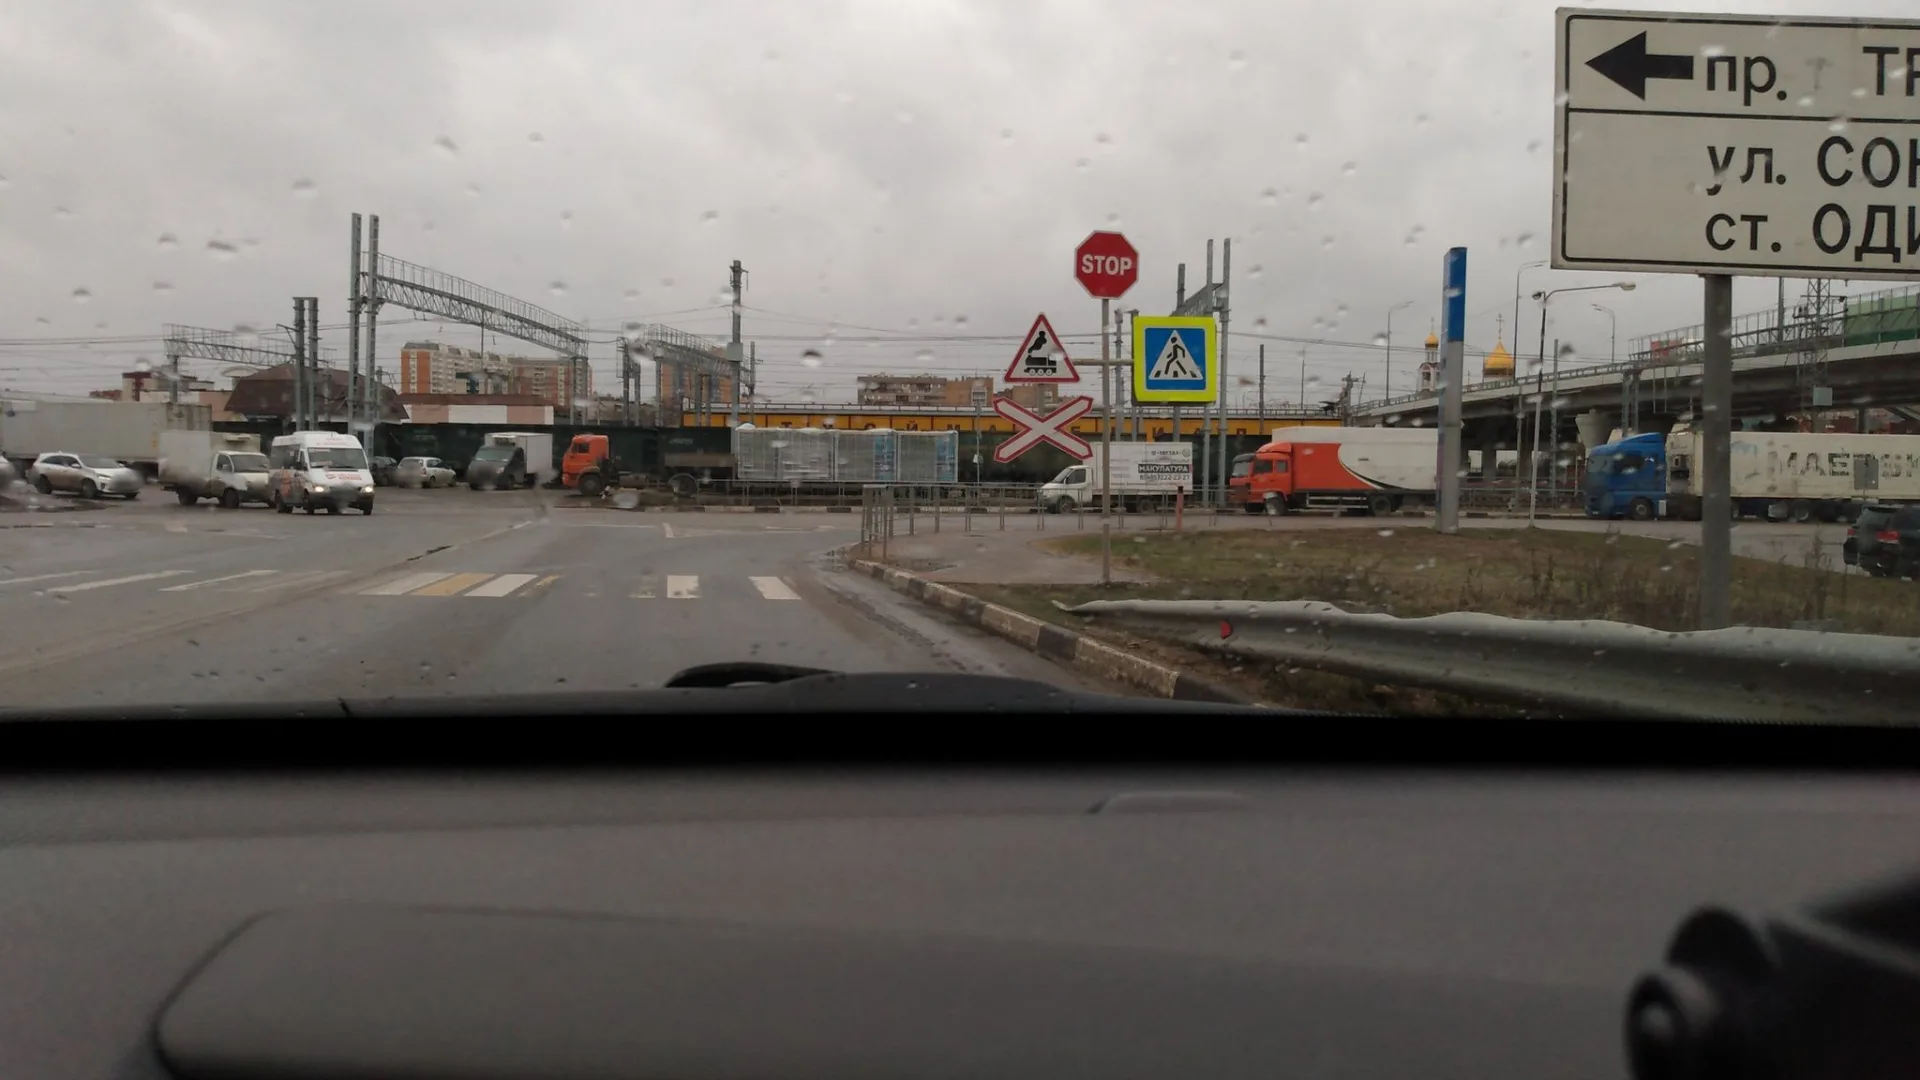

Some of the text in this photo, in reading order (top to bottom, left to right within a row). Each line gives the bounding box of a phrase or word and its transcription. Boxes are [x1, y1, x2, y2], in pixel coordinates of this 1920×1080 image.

[1706, 55, 1788, 107] пр.
[1706, 146, 1787, 196] ул.
[1705, 213, 1782, 253] ст.
[1081, 254, 1133, 276] STOP
